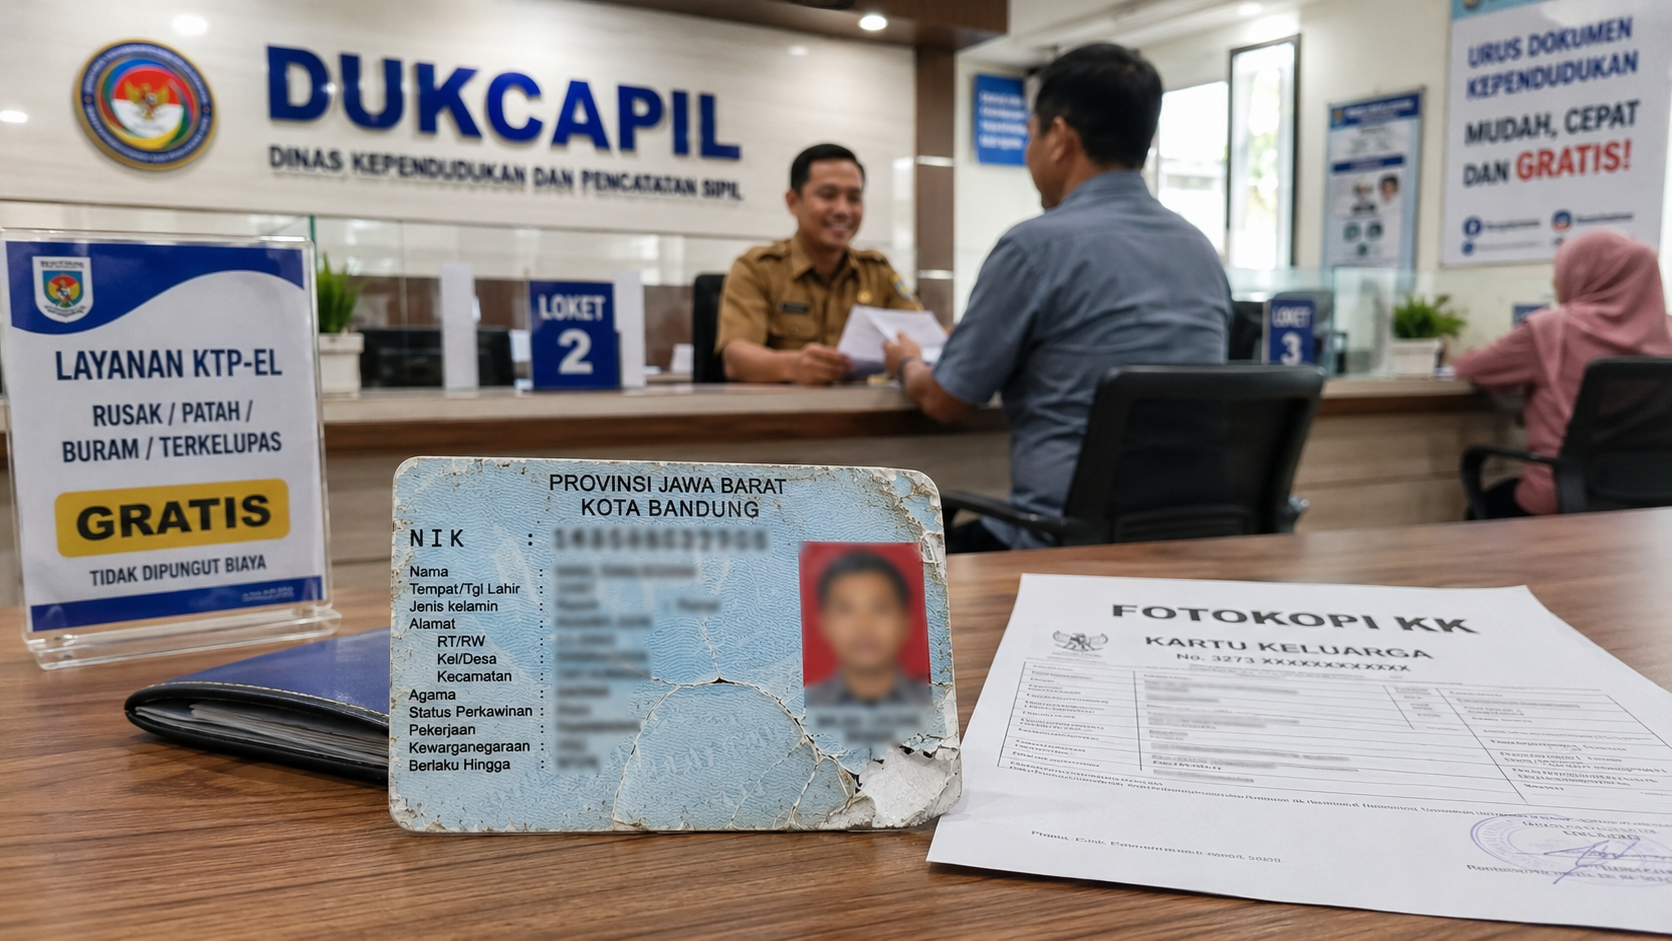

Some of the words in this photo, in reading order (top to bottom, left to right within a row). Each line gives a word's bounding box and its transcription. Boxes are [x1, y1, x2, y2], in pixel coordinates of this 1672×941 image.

[1467, 36, 1523, 69] URUS
[1528, 17, 1633, 58] DOKUMEN
[1466, 50, 1639, 99] KEPENDUDUKAN
[266, 46, 742, 160] DUKCAPIL
[1464, 112, 1558, 147] MUDAH,
[1564, 99, 1641, 136] CEPAT
[269, 146, 344, 171] DINAS
[351, 151, 526, 184] KEPENDUDUKAN
[533, 165, 574, 188] DAN
[582, 168, 697, 196] PENCATATAN
[702, 178, 743, 200] SIPIL
[1463, 160, 1510, 188] DAN
[1516, 139, 1632, 182] GRATIS!
[538, 293, 606, 321] LOKET
[1272, 306, 1312, 329] LOKET
[557, 328, 593, 375] 2
[1281, 331, 1303, 367] 3
[55, 350, 183, 380] LAYANAN
[193, 349, 283, 378] KTP-EL
[92, 403, 164, 427] RUSAK
[168, 402, 176, 426] /
[182, 401, 241, 423] PATAH
[245, 400, 254, 422] /
[62, 438, 140, 463] BURAM
[145, 436, 154, 460] /
[159, 432, 283, 458] TERKELUPAS
[550, 474, 651, 492] PROVINSI
[659, 477, 715, 493] JAWA
[721, 477, 787, 495] BARAT
[76, 494, 272, 541] GRATIS
[582, 499, 640, 516] KOTA
[648, 500, 759, 518] BANDUNG
[411, 529, 464, 547] NIK
[89, 566, 139, 587] TIDAK
[142, 558, 221, 583] DIPUNGUT
[225, 554, 267, 574] BIAYA
[410, 566, 448, 577] Nama
[410, 583, 483, 597] Tempat/Tgl
[488, 583, 520, 594] Lahir
[410, 600, 443, 612] Jenis
[449, 600, 498, 612] kelamin
[409, 618, 455, 629] Alamat
[1111, 604, 1380, 630] FOTOKOPI
[1394, 616, 1479, 634] KK
[438, 636, 485, 647] RT/RW
[1145, 636, 1248, 651] KARTU
[1257, 642, 1435, 660] KELUARGA
[438, 653, 496, 665] Kel/Desa
[1176, 653, 1205, 662] No.
[1211, 655, 1255, 664] 3273
[438, 671, 511, 682] Kecamatan
[409, 689, 455, 703] Agama
[409, 706, 451, 718] Status
[456, 705, 532, 717] Perkawinan
[410, 724, 475, 738] Pekerjaan
[410, 742, 530, 756] Kewarganegaraan
[410, 759, 460, 772] Berlaku
[464, 759, 511, 775] Hingga
